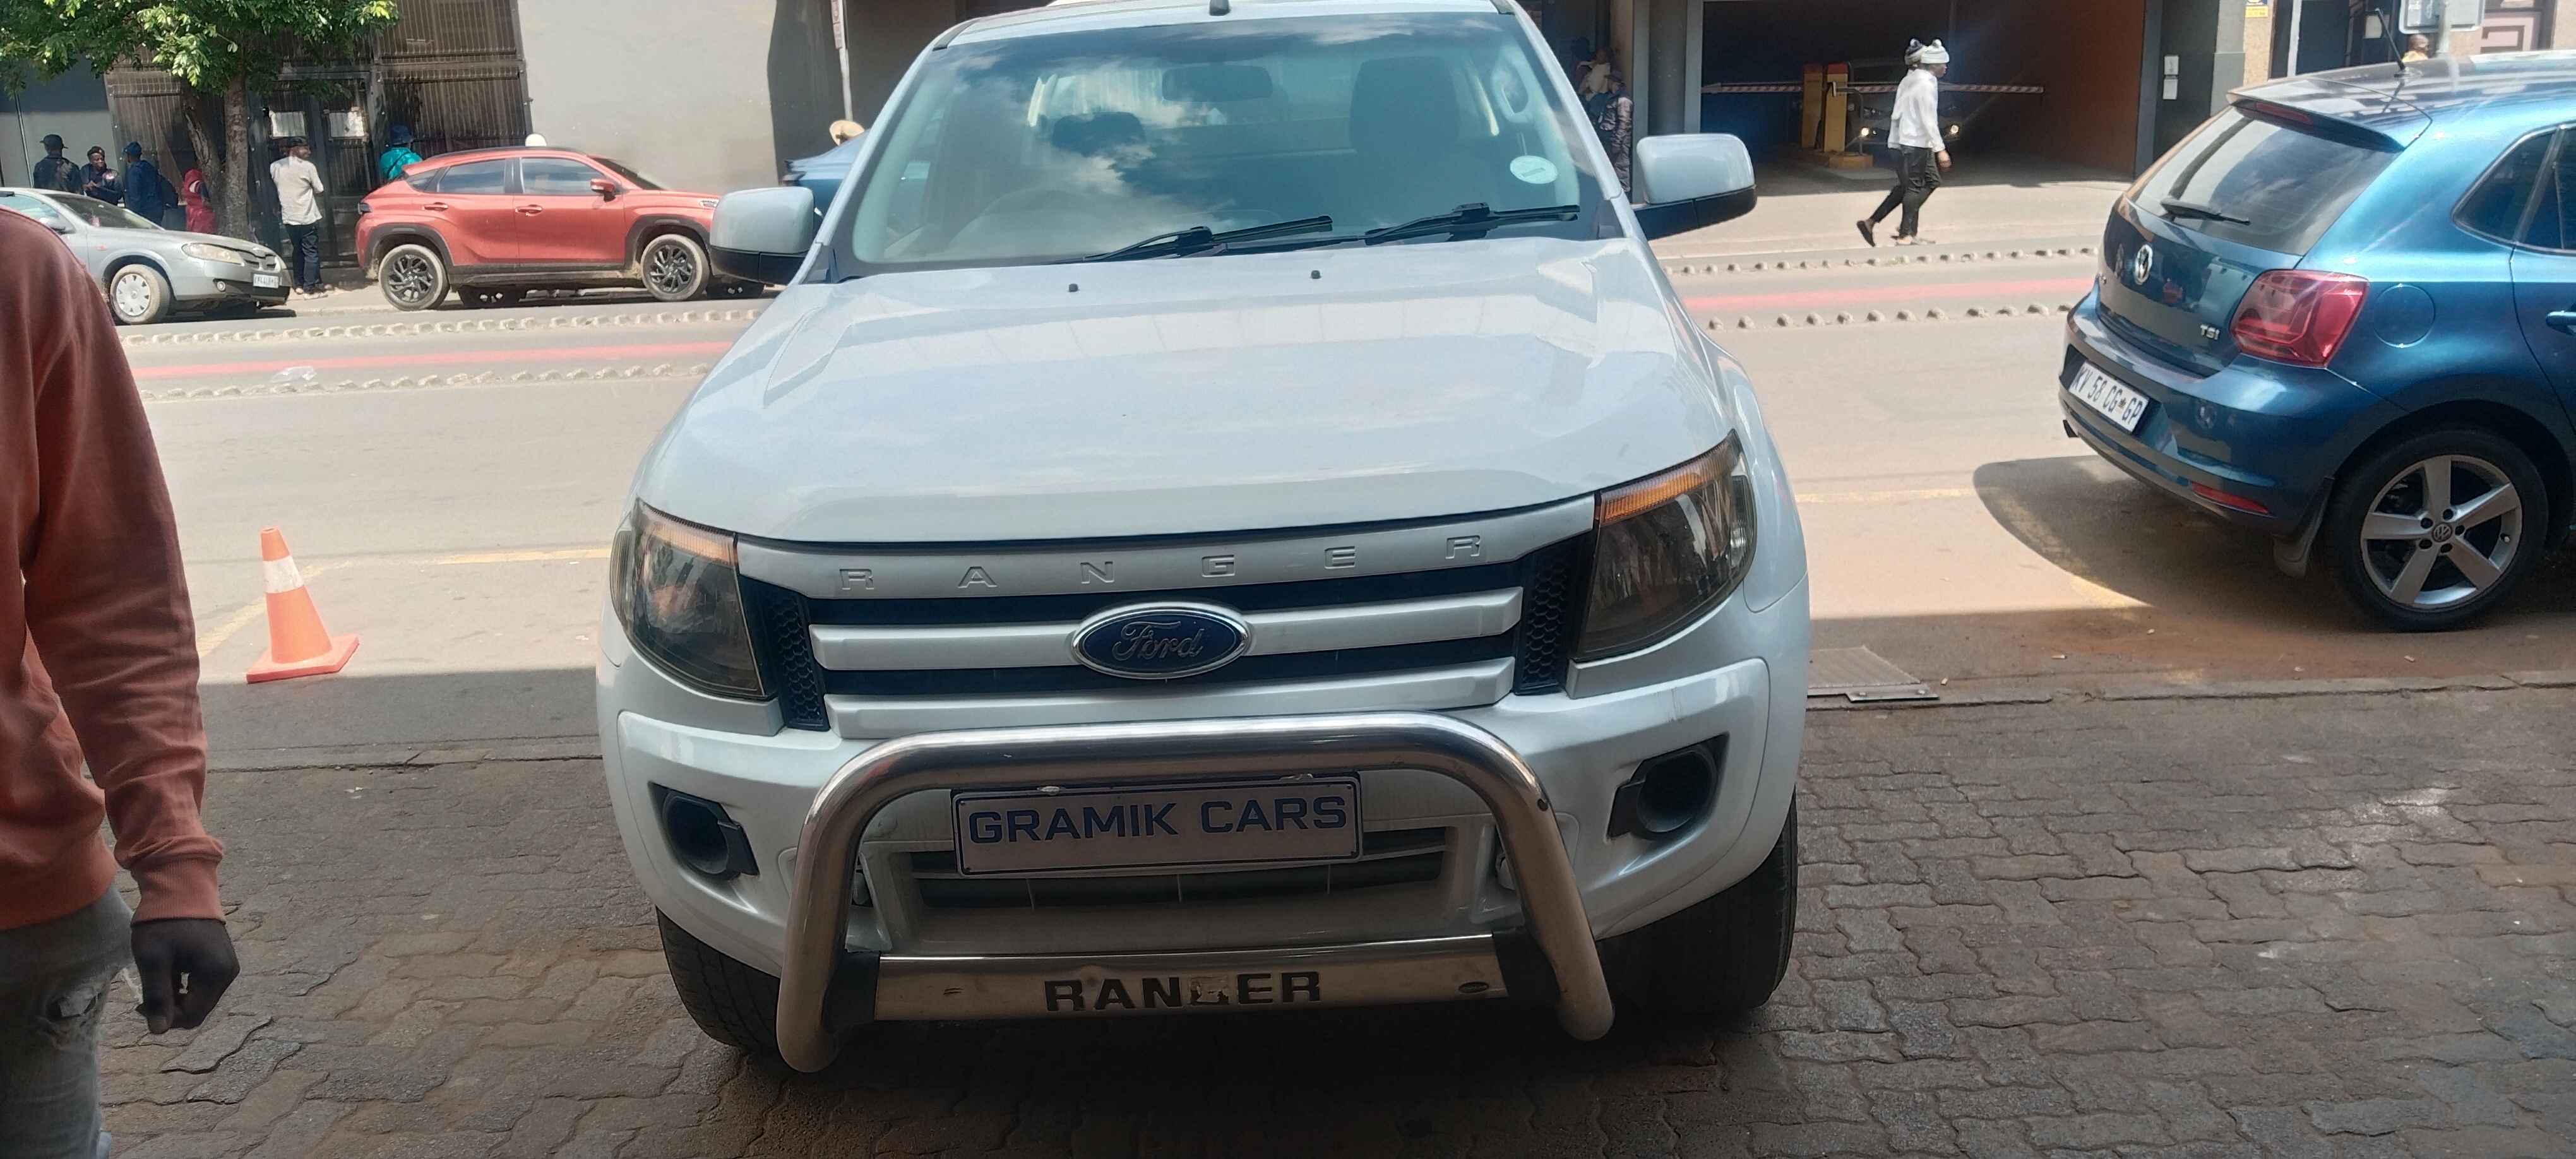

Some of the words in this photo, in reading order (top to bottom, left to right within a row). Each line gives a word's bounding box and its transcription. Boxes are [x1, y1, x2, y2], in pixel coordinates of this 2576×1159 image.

[2200, 324, 2220, 340] TSI
[2073, 366, 2093, 392] KV
[2088, 376, 2107, 402] 58
[2103, 386, 2123, 413] CG
[2122, 397, 2143, 424] GP
[839, 535, 1482, 591] RANGER
[1112, 621, 1205, 661] Ford
[969, 802, 1179, 845] GRAMIK
[1200, 795, 1347, 833] CARS
